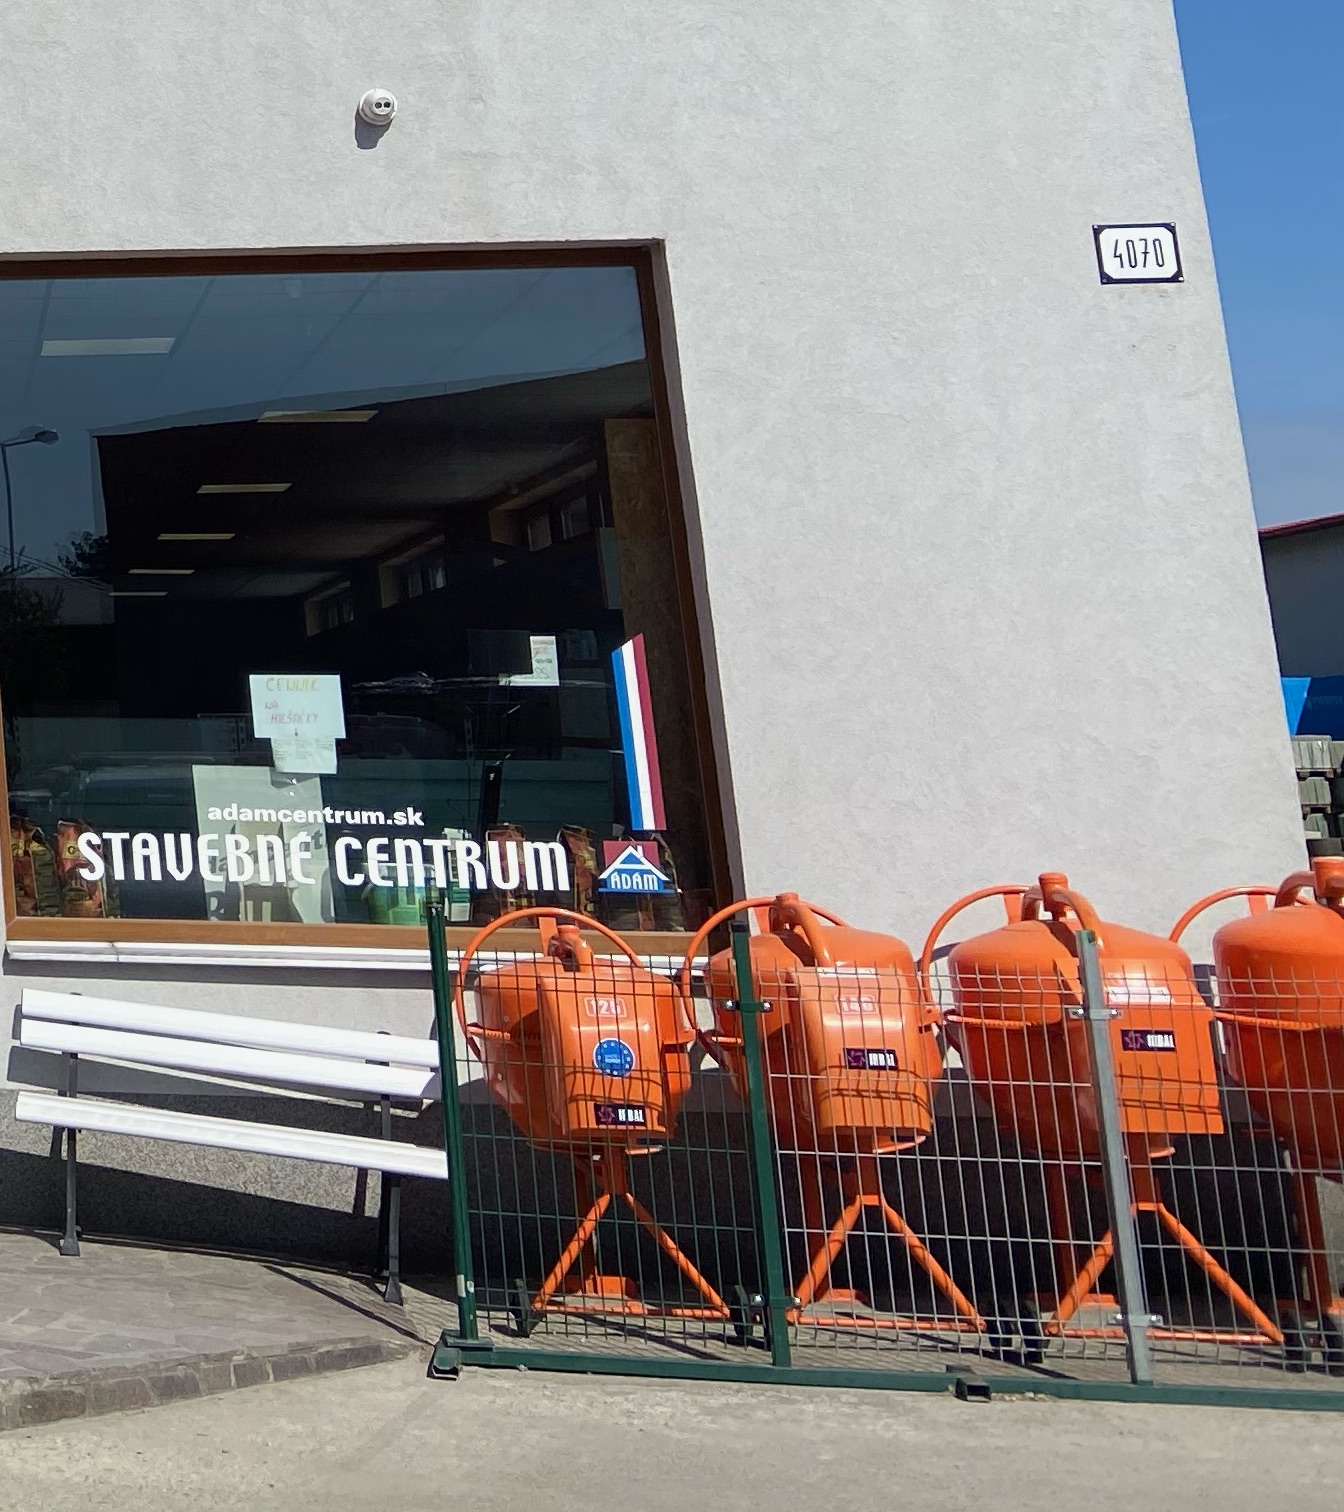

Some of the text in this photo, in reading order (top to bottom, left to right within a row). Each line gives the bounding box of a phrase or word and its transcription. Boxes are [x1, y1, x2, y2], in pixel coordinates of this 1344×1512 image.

[1113, 238, 1165, 268] 4070
[207, 803, 425, 827] adamcentrum.sk
[76, 831, 316, 885] STAVEBNÉ
[334, 837, 570, 891] CENTRUM
